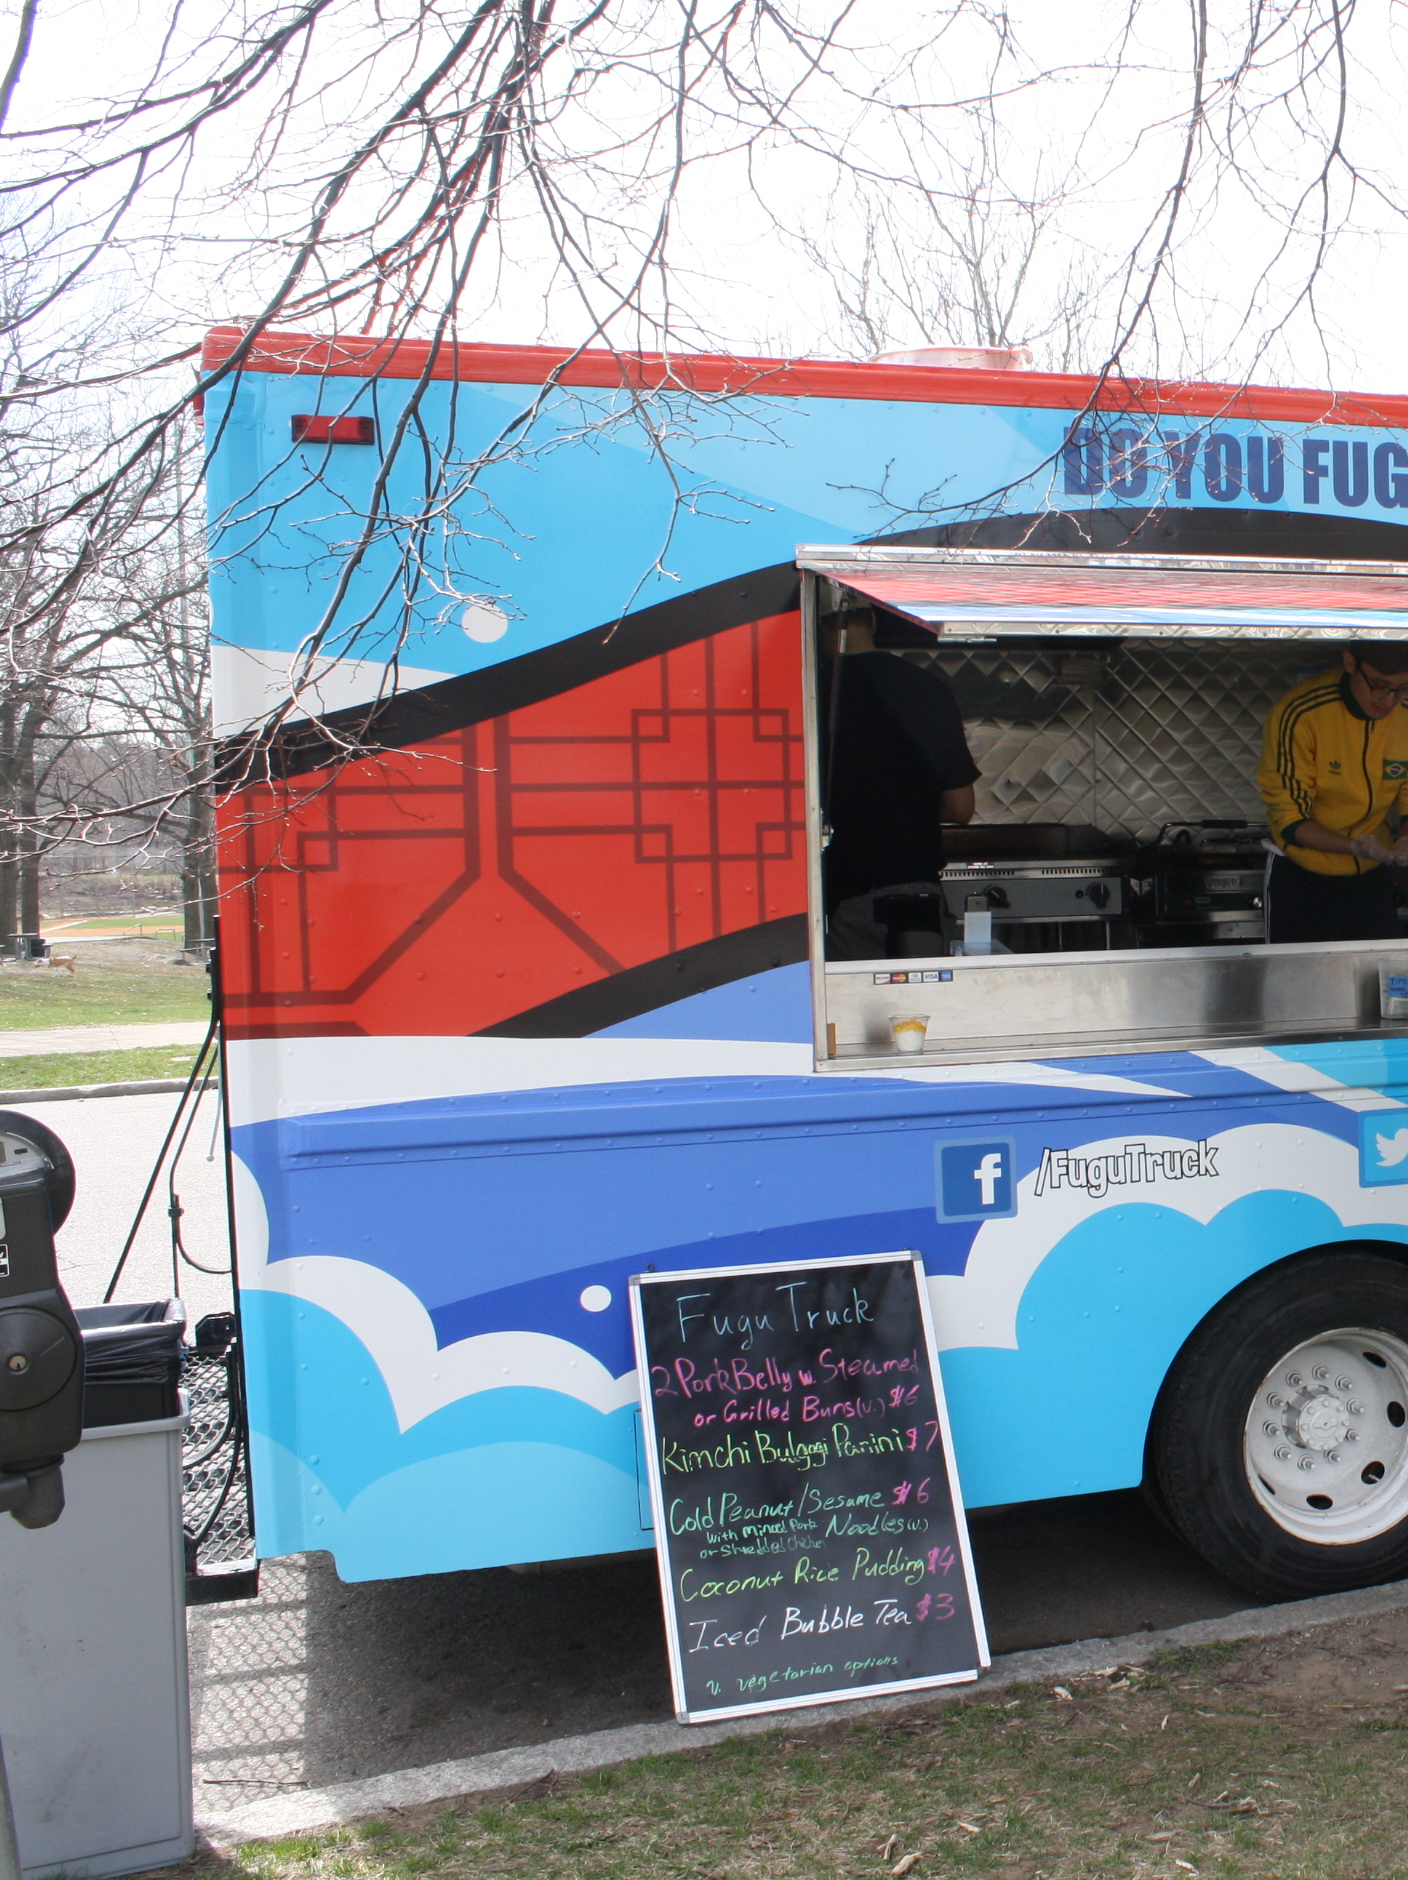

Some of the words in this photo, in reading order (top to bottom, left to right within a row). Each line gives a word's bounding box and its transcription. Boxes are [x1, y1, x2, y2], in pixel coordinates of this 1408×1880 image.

[1063, 426, 1148, 498] DO
[1163, 432, 1286, 504] YOU
[1034, 1139, 1220, 1199] /FuguTruck
[676, 1293, 775, 1350] Fugu
[775, 1281, 875, 1333] Truck
[650, 1365, 679, 1397] 2
[673, 1357, 738, 1399] Pork
[730, 1356, 793, 1393] Belly
[818, 1348, 919, 1383] Steamed
[693, 1412, 717, 1427] or
[723, 1397, 790, 1423] Grilled
[887, 1384, 920, 1408] $6
[661, 1433, 752, 1475] Kimchi
[831, 1422, 904, 1457] Panini
[905, 1420, 939, 1452] $7
[669, 1498, 715, 1536] Cold
[890, 1477, 931, 1506] $6
[824, 1510, 905, 1538] Noodles
[680, 1567, 784, 1602] Coconut
[793, 1556, 840, 1585] Rice
[850, 1546, 926, 1586] Pudding
[926, 1545, 956, 1577] $4
[688, 1614, 768, 1654] Iced
[780, 1604, 865, 1641] Bubble
[873, 1598, 913, 1626] Tea
[915, 1592, 956, 1623] $3
[843, 1655, 899, 1678] options
